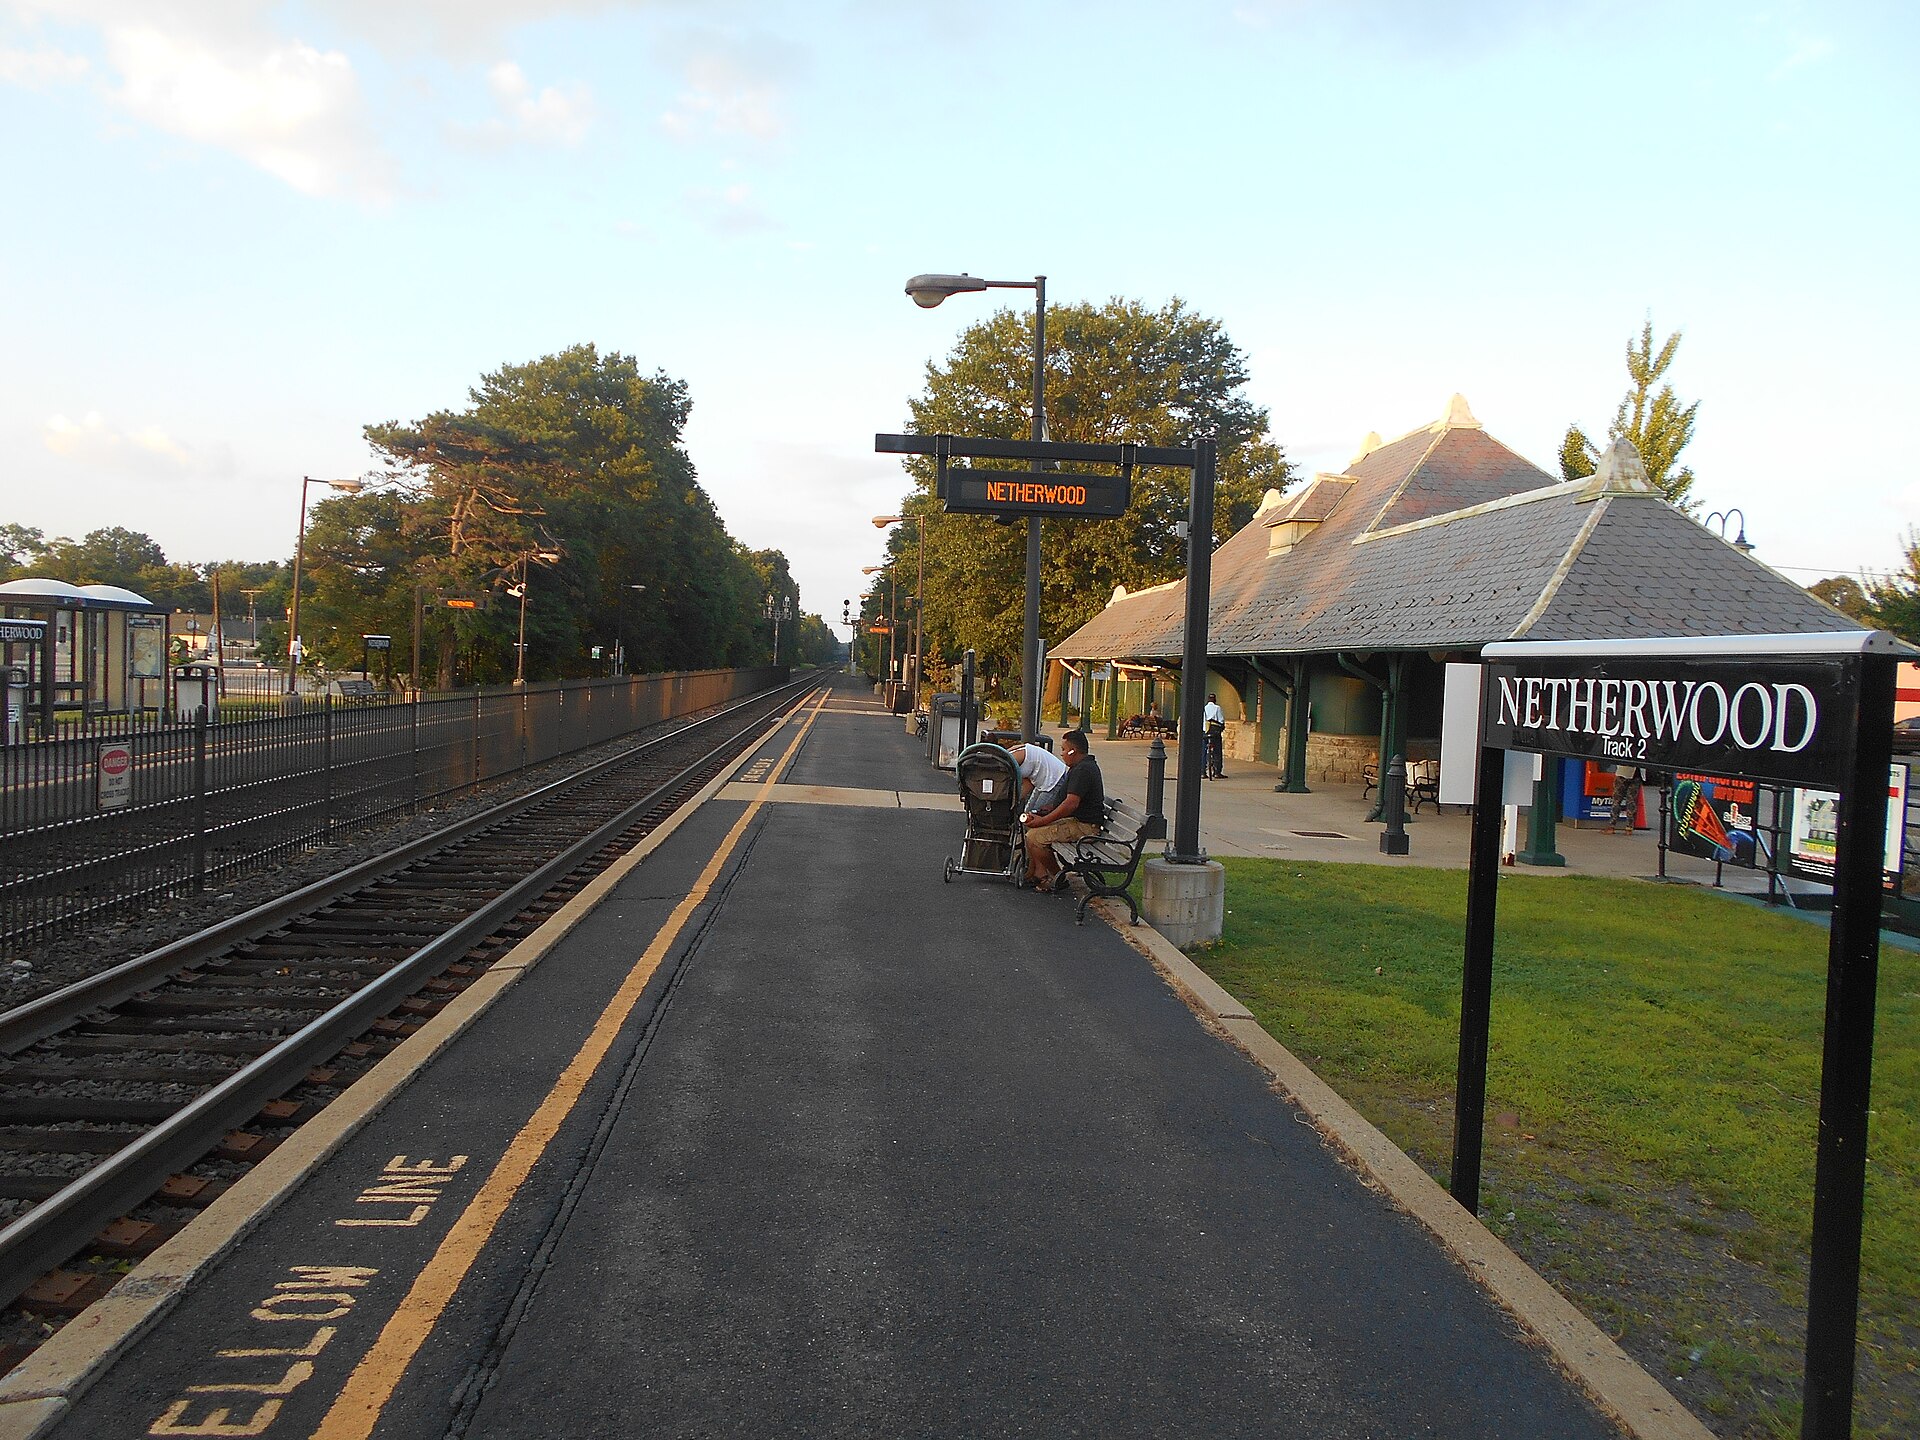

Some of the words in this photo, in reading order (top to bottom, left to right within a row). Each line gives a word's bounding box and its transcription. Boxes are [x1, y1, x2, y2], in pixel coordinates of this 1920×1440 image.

[986, 481, 1086, 505] NETHERWOOD
[1497, 676, 1817, 753] NETHERWOOD
[1602, 735, 1633, 758] Track
[1636, 738, 1647, 760] 2
[148, 1265, 380, 1436] ELLOW
[335, 1155, 469, 1227] LINE
